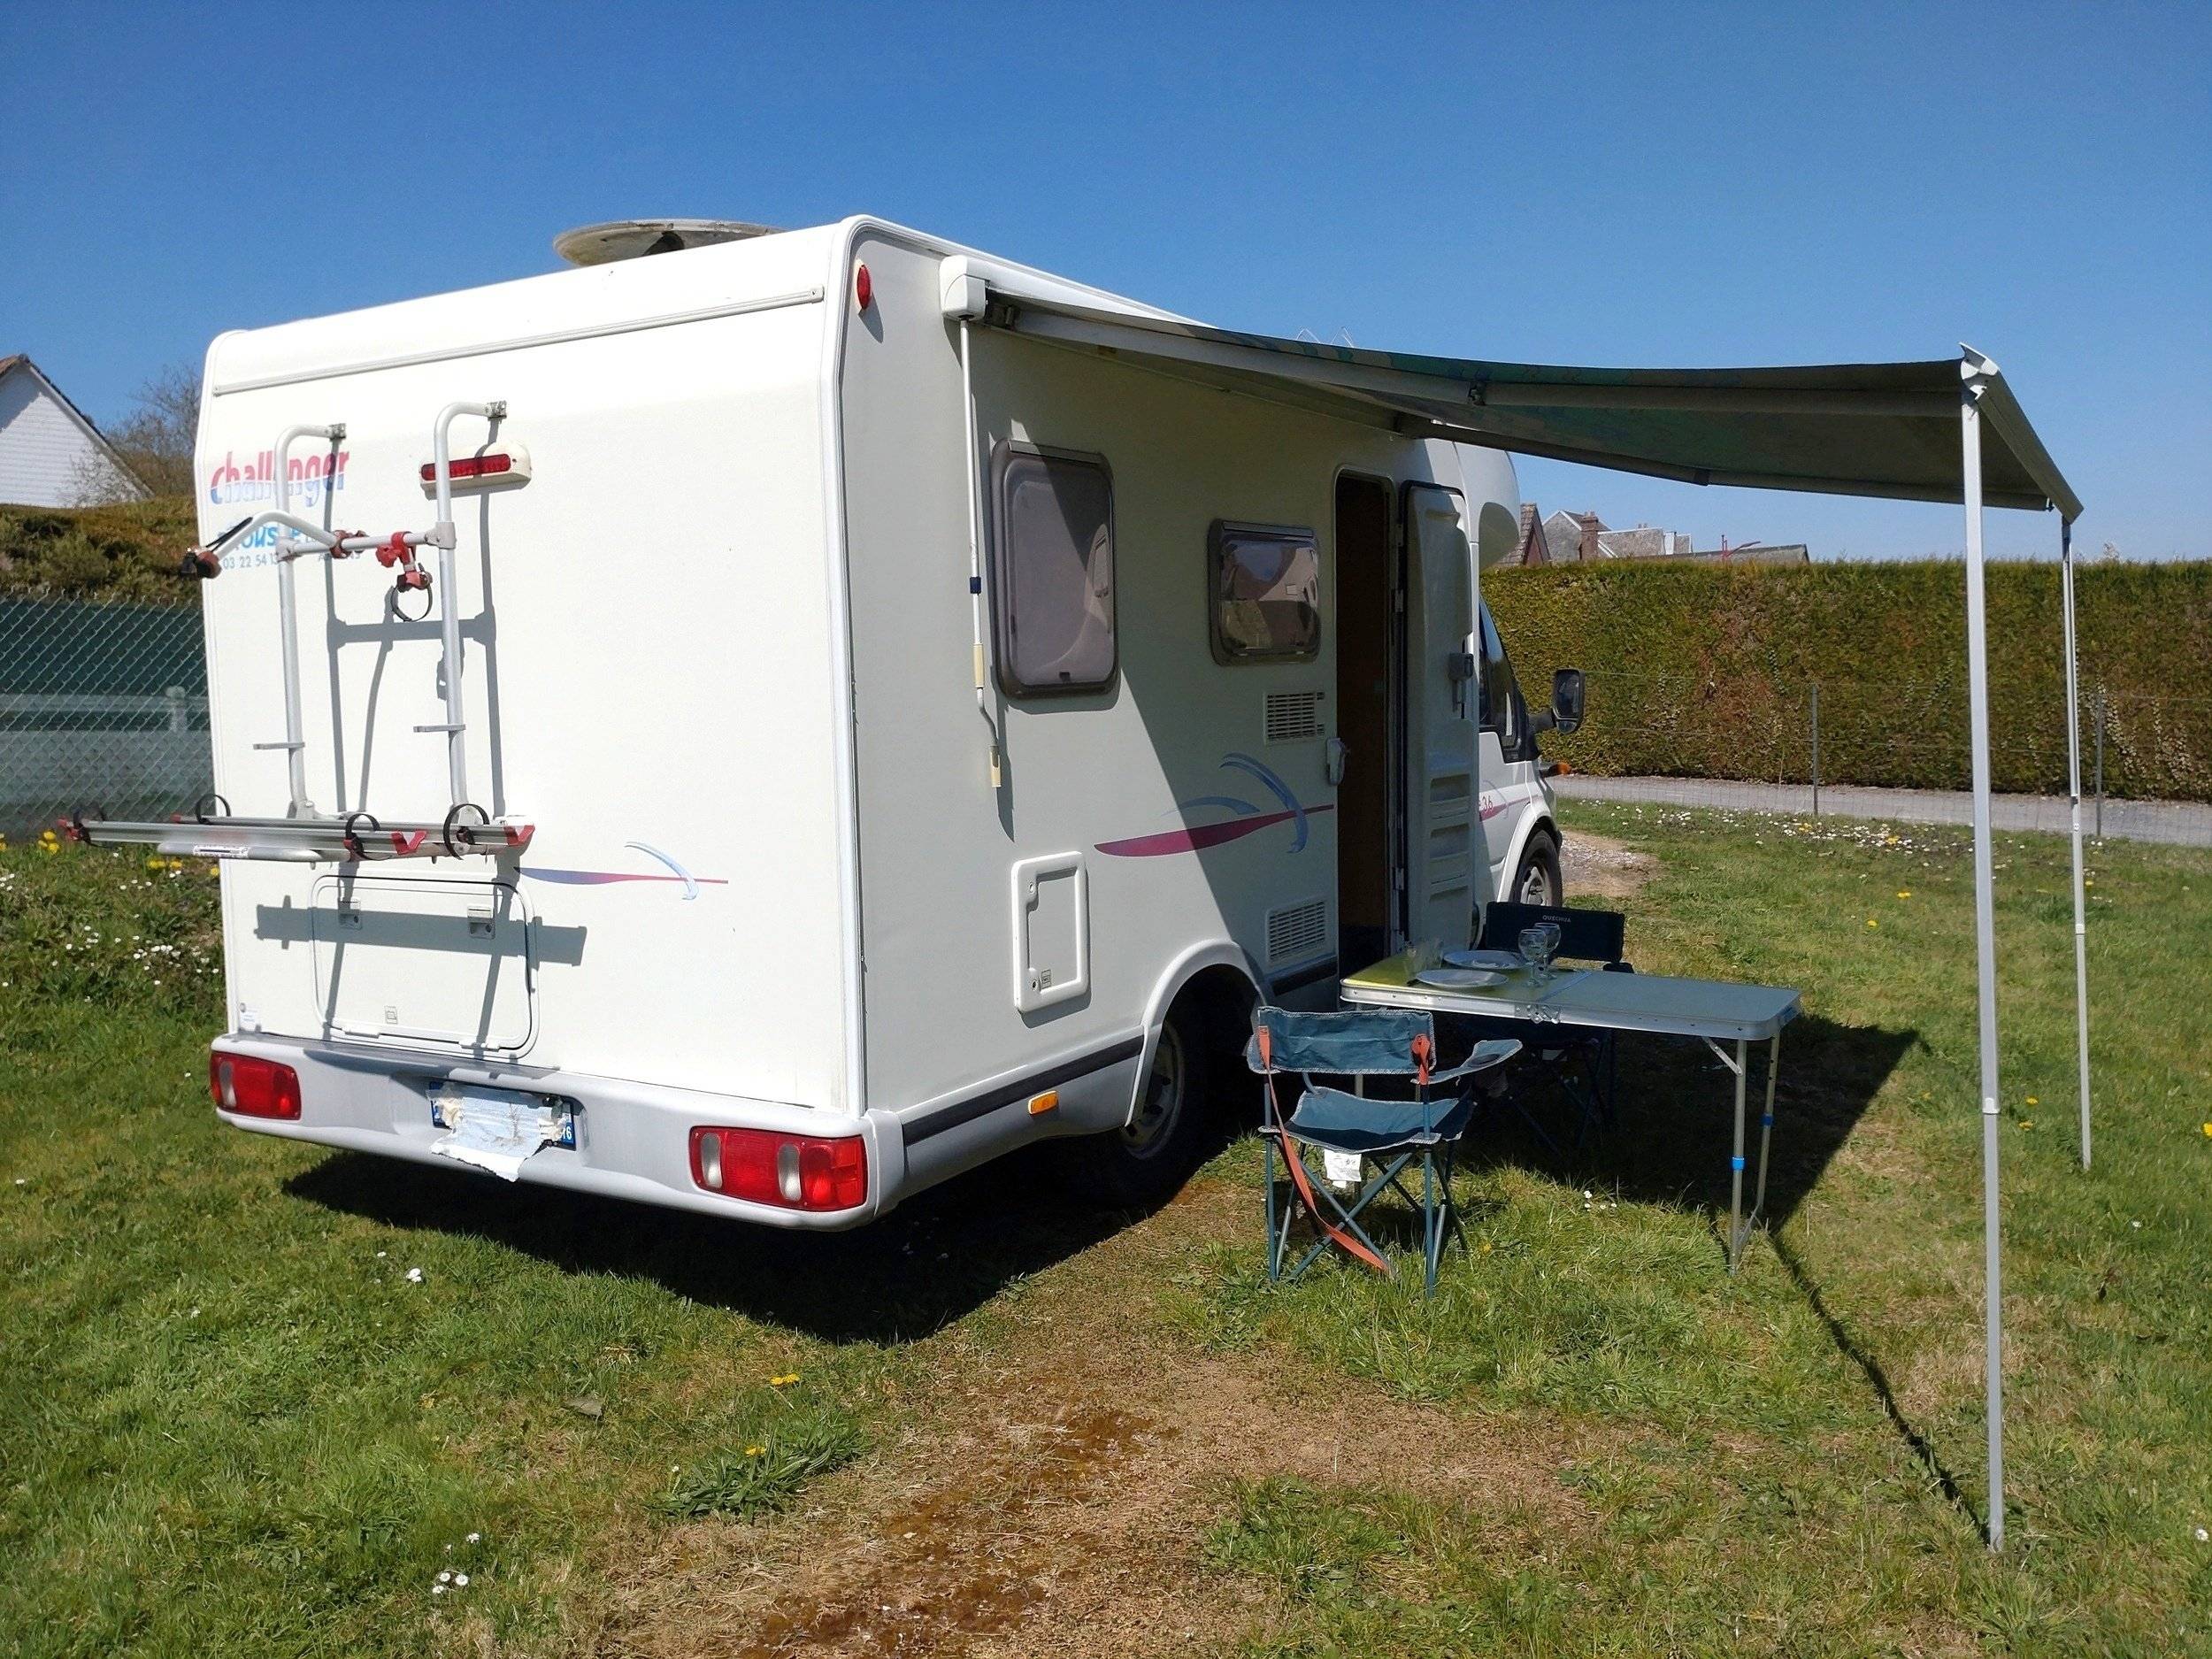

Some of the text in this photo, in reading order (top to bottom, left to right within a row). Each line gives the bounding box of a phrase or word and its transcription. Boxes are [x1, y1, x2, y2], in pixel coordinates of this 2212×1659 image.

[211, 450, 349, 507] challnger
[222, 557, 235, 569] 03
[240, 555, 252, 568] 22
[255, 553, 267, 567] 54
